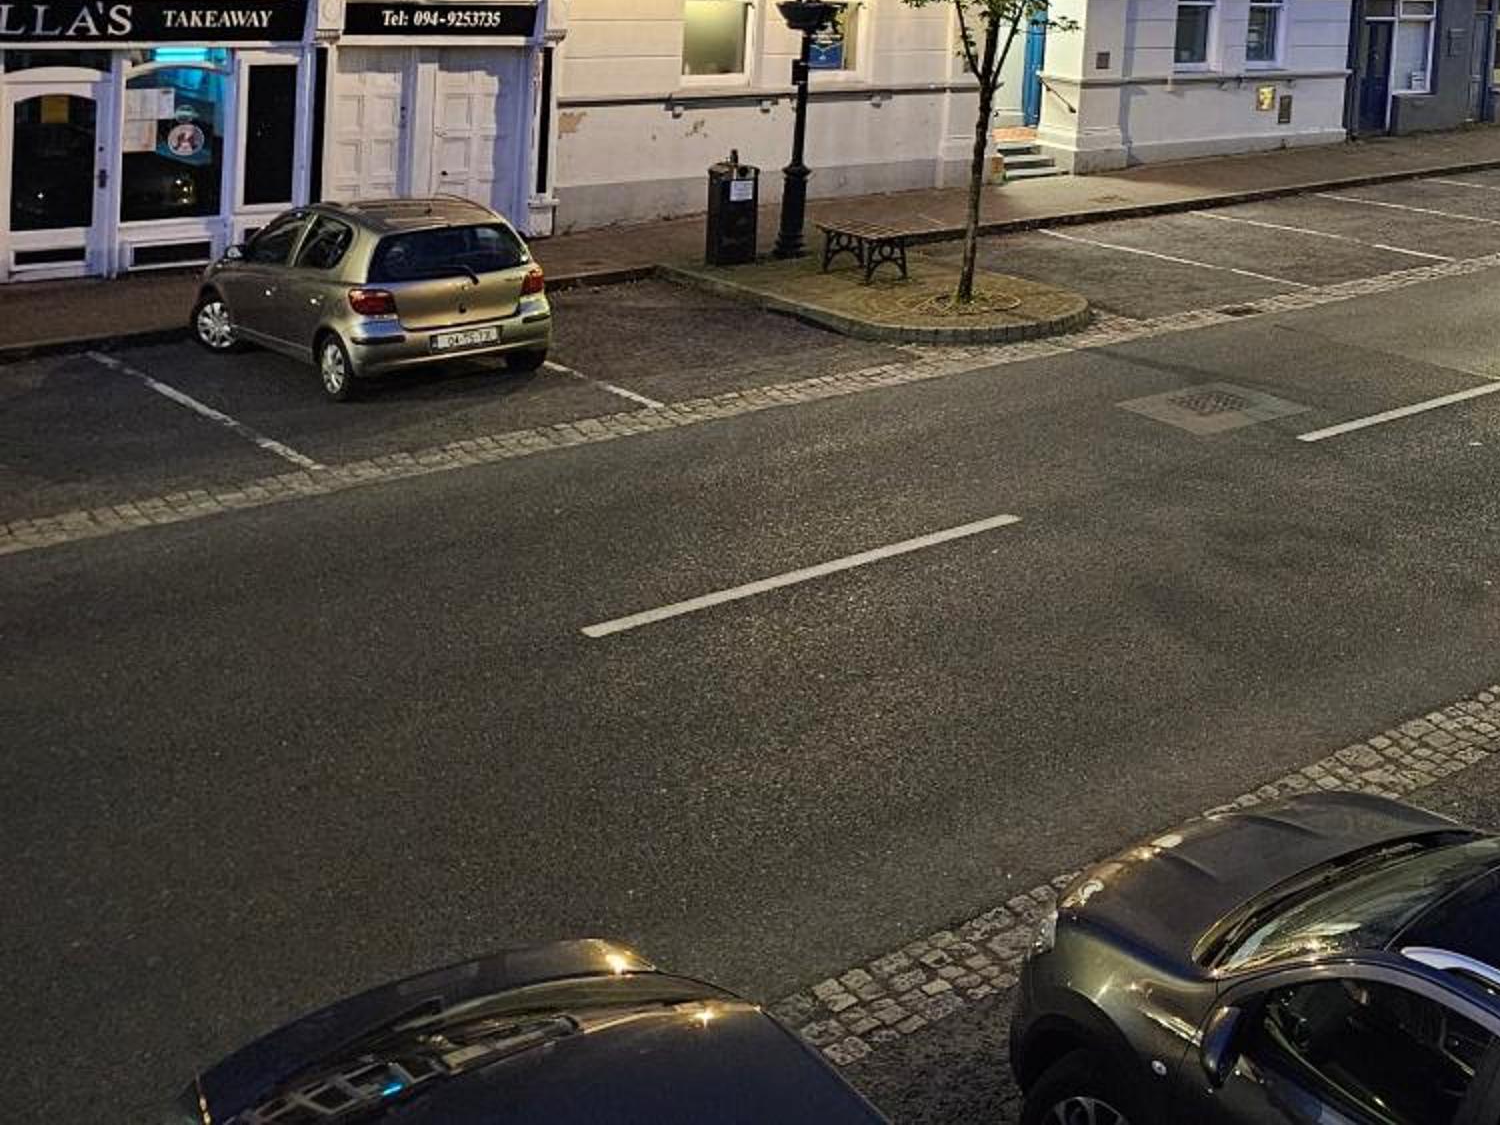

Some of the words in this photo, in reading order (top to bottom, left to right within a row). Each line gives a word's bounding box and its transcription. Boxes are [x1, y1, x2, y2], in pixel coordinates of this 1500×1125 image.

[163, 10, 273, 28] TAKEAWAY
[382, 10, 408, 26] Tel:
[413, 10, 501, 28] 094-9253735
